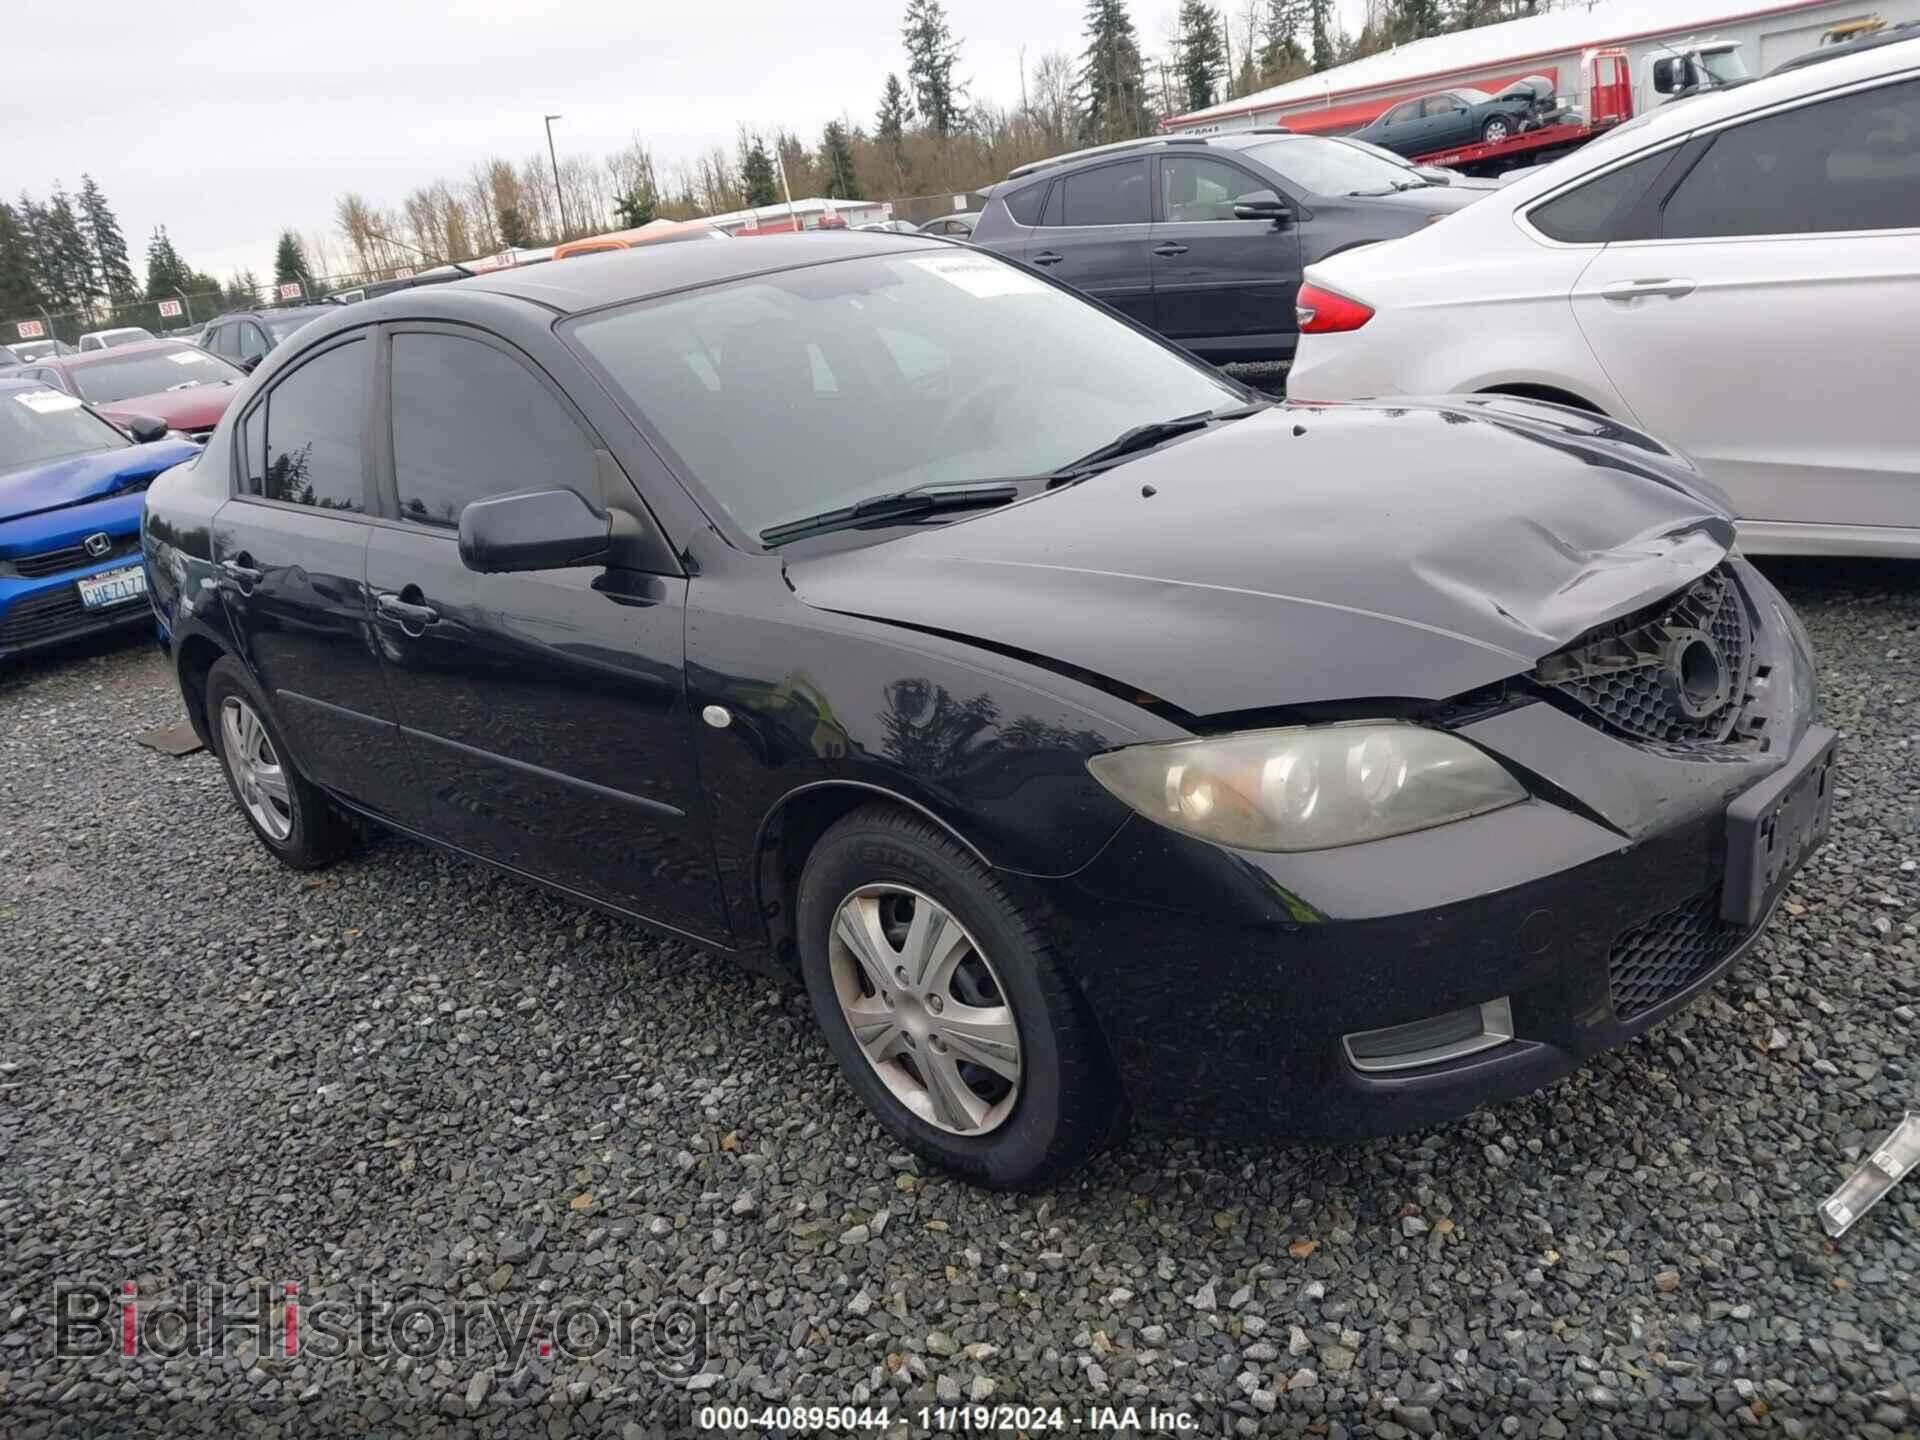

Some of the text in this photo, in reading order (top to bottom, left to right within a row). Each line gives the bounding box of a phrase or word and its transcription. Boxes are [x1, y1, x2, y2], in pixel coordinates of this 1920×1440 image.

[283, 284, 300, 298] SF6
[161, 302, 180, 315] SF7
[20, 322, 42, 337] SF8
